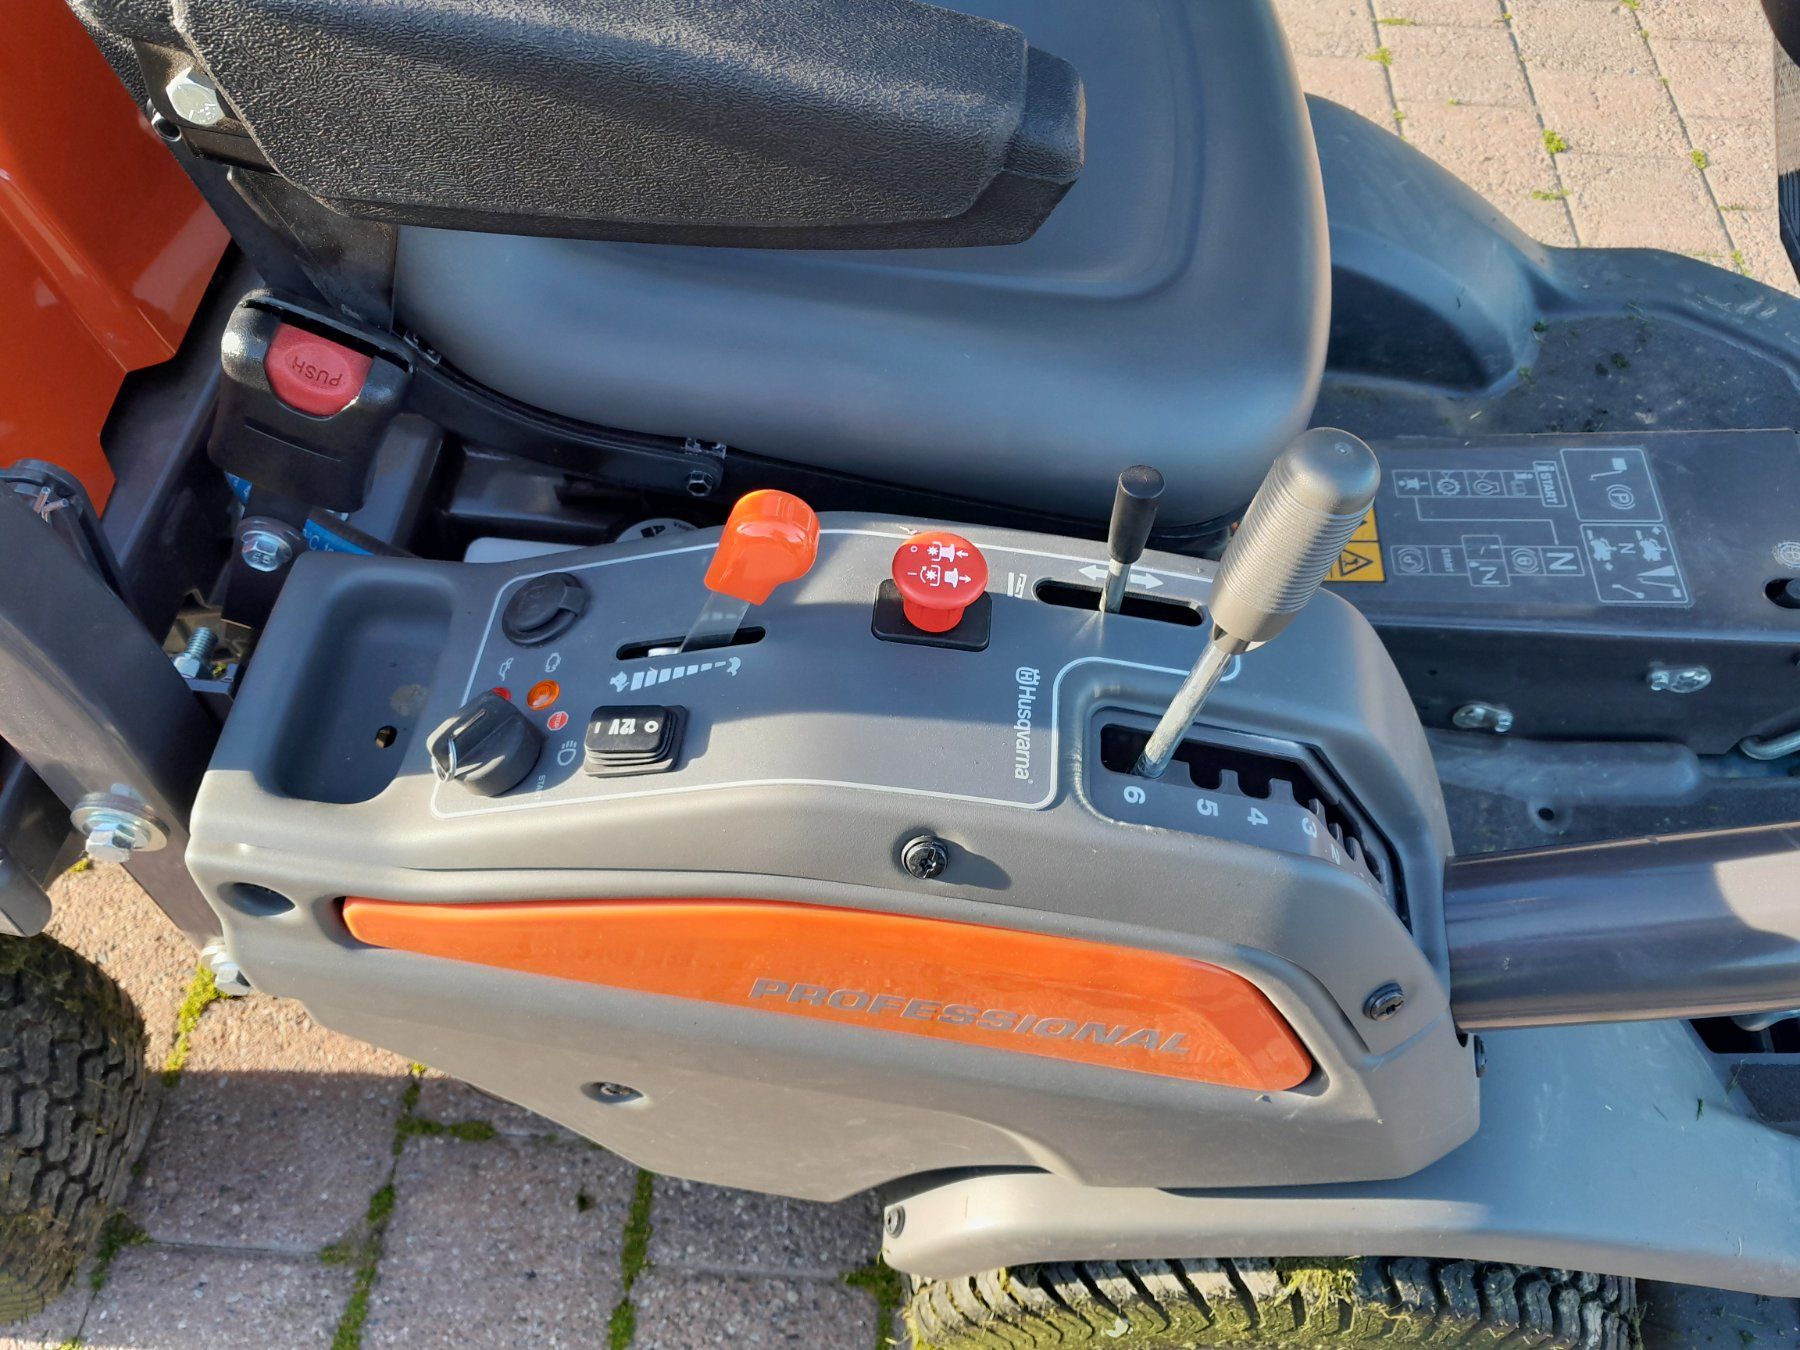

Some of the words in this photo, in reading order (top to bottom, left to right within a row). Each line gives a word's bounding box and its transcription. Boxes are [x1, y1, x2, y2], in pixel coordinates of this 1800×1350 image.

[292, 356, 342, 387] PUSH
[1540, 472, 1558, 504] START
[1617, 542, 1636, 554] N
[1546, 552, 1578, 571] N
[1479, 567, 1501, 584] N
[608, 718, 637, 736] 12V
[1014, 684, 1038, 781] Husqvarna
[1123, 785, 1146, 805] 6
[1197, 798, 1219, 817] 5
[1247, 807, 1269, 826] 4
[1301, 817, 1318, 839] 3
[1331, 843, 1341, 865] 2
[747, 976, 1191, 1054] PROFESSIONAL
